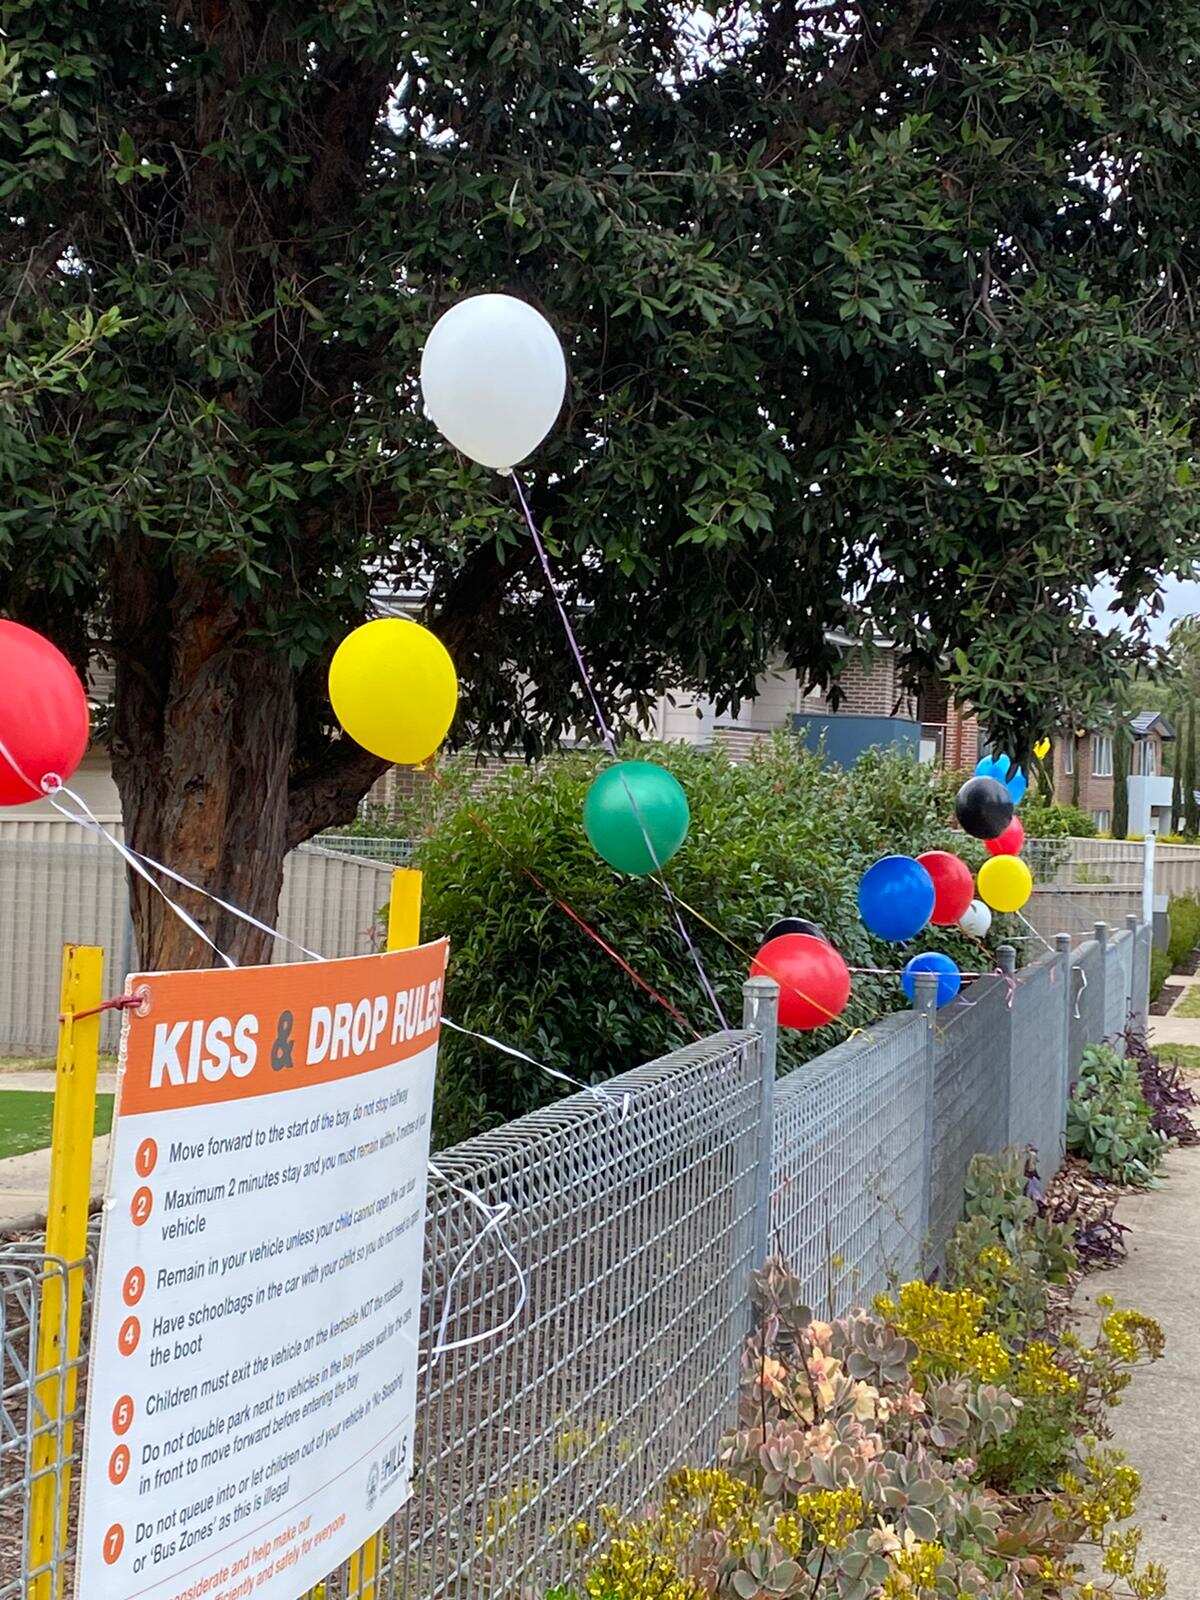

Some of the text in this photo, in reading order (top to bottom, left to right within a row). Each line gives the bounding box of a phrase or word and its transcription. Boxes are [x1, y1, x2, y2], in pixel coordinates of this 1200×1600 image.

[149, 1013, 260, 1089] KISS
[271, 1009, 296, 1072] &
[305, 995, 388, 1066] DROP
[136, 1196, 147, 1217] 2
[164, 1184, 225, 1211] Maximum
[228, 1178, 236, 1197] 2
[238, 1170, 279, 1194] minutes
[281, 1162, 302, 1184] stay
[303, 1156, 320, 1177] and
[320, 1154, 335, 1175] you
[337, 1145, 357, 1166] must
[357, 1139, 379, 1158] remain
[142, 1147, 150, 1169] 1
[169, 1142, 205, 1163] Move
[208, 1129, 253, 1156] forward
[255, 1130, 266, 1147] to
[269, 1123, 285, 1143] the
[286, 1118, 309, 1139] start
[311, 1114, 321, 1134] of
[321, 1112, 335, 1130] the
[336, 1108, 351, 1128] bay,
[353, 1104, 362, 1121] do
[362, 1101, 375, 1117] not
[375, 1095, 389, 1113] stop
[129, 1276, 139, 1296] 3
[157, 1260, 205, 1289] Remain
[208, 1256, 219, 1277] in
[221, 1250, 247, 1276] your
[249, 1237, 284, 1263] vehicle
[286, 1228, 315, 1251] unless
[315, 1221, 334, 1244] your
[334, 1209, 353, 1232] child
[353, 1202, 375, 1224] cannot
[162, 1214, 206, 1241] vehicle
[124, 1325, 135, 1345] 4
[152, 1314, 185, 1338] Have
[188, 1293, 253, 1326] schoolbags
[255, 1286, 265, 1304] in
[267, 1279, 283, 1300] the
[284, 1275, 301, 1294] car
[301, 1264, 319, 1286] with
[319, 1259, 338, 1284] your
[338, 1249, 356, 1271] child
[356, 1246, 365, 1262] so
[365, 1240, 377, 1260] you
[118, 1404, 128, 1426] 5
[146, 1385, 198, 1415] Children
[201, 1371, 230, 1396] must
[231, 1362, 251, 1384] exit
[253, 1356, 269, 1376] the
[271, 1340, 302, 1367] vehicle
[303, 1335, 315, 1352] on
[315, 1327, 329, 1346] the
[329, 1310, 359, 1338] kerbside
[359, 1298, 375, 1320] NOT
[150, 1334, 203, 1367] the boot
[114, 1453, 125, 1475] 6
[142, 1443, 160, 1465] Do
[163, 1432, 184, 1457] not
[187, 1417, 225, 1447] double
[227, 1404, 250, 1434] park
[252, 1393, 274, 1418] next
[275, 1388, 285, 1407] to
[287, 1373, 321, 1401] vehicles
[321, 1367, 329, 1384] in
[329, 1359, 342, 1377] the
[342, 1352, 355, 1371] bay
[139, 1371, 360, 1495] in front to move forward before entering the bay
[109, 1532, 120, 1556] 7
[135, 1522, 154, 1544] Do
[156, 1511, 177, 1534] not
[179, 1495, 213, 1526] queue
[216, 1483, 236, 1507] into
[238, 1477, 250, 1496] or
[251, 1466, 264, 1487] let
[265, 1448, 303, 1479] children
[301, 1438, 315, 1459] out
[315, 1430, 325, 1449] of
[324, 1422, 342, 1448] your
[342, 1404, 365, 1432] vehicle
[133, 1475, 290, 1574] or 'Bus Zones' as this is illegal
[231, 1549, 250, 1577] and
[252, 1540, 272, 1565] help
[273, 1526, 297, 1550] make
[298, 1514, 312, 1535] our
[256, 1561, 274, 1586] and
[275, 1546, 301, 1574] safely
[301, 1538, 313, 1555] for
[314, 1512, 346, 1546] everyone
